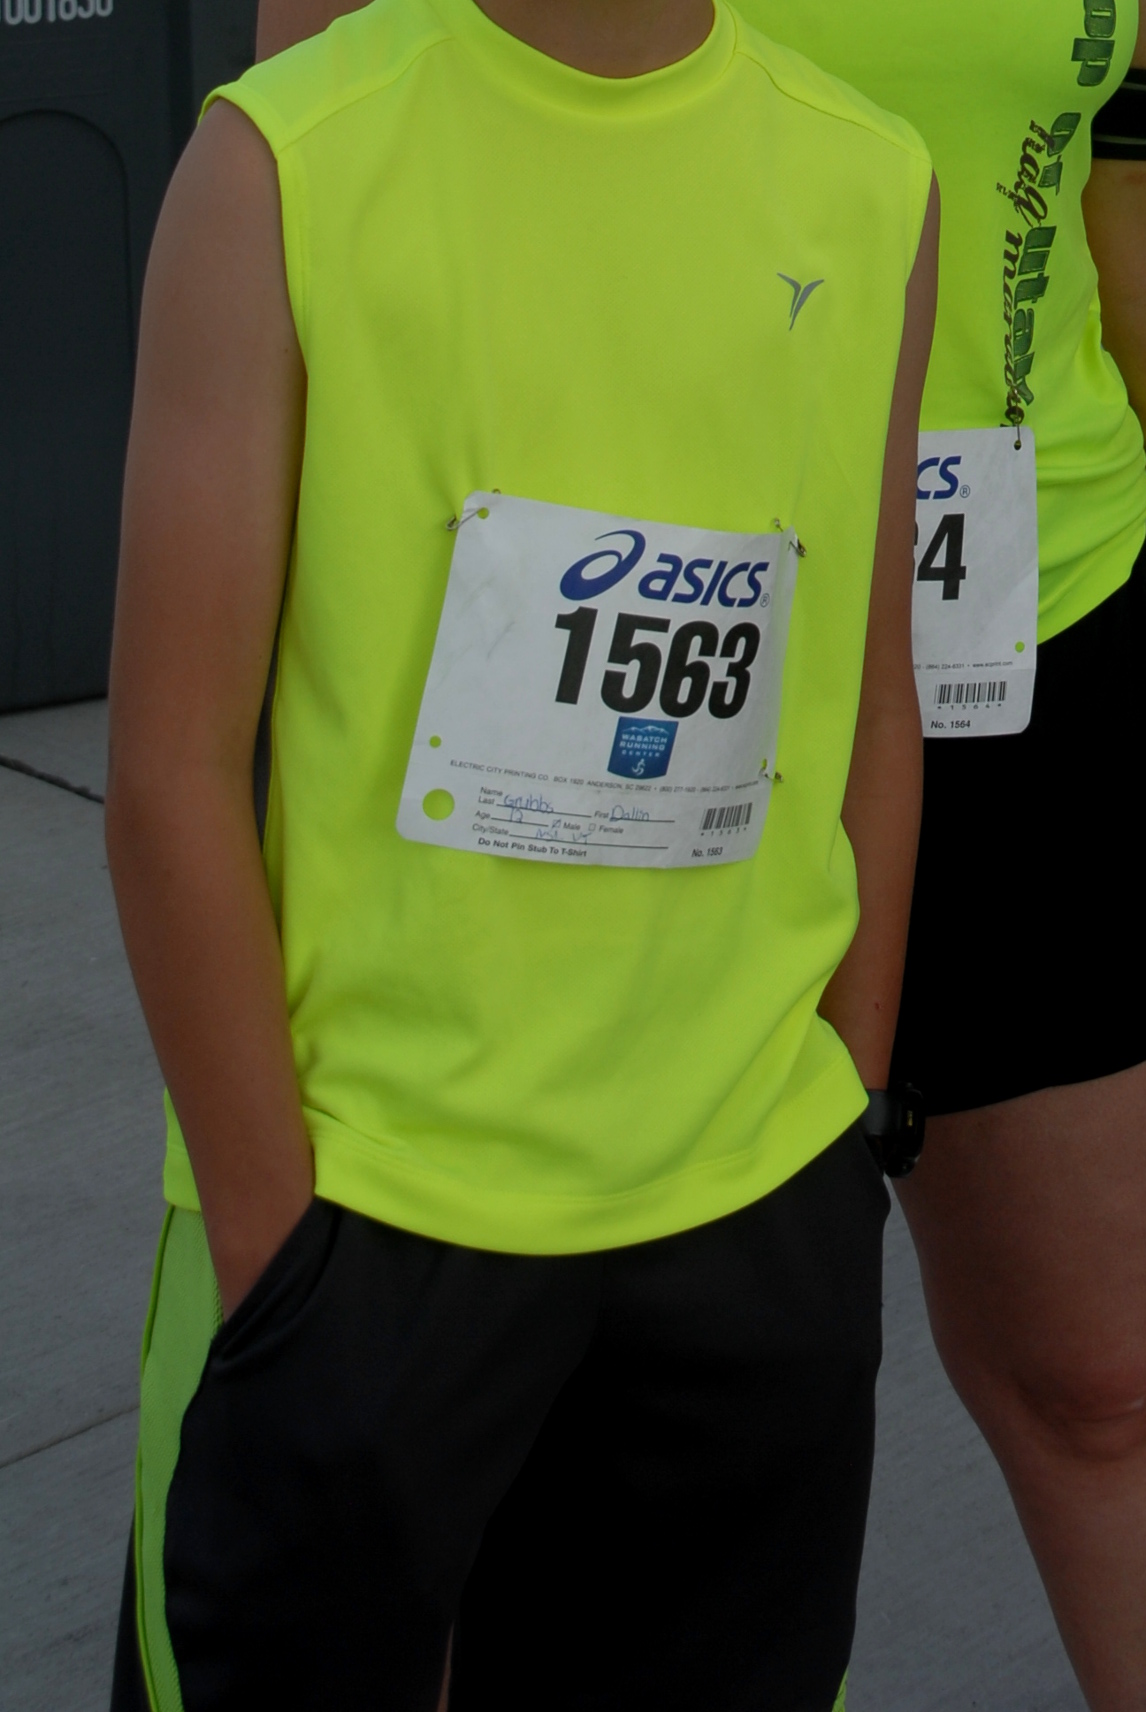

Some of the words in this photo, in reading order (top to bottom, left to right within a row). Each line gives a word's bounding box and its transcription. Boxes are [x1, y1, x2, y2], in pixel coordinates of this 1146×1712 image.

[999, 230, 1026, 427] maratho
[914, 513, 967, 601] 4
[637, 552, 770, 608] asics
[554, 606, 761, 719] 1563
[930, 720, 947, 729] No.
[950, 719, 971, 728] 1564
[619, 741, 666, 751] RUNNING
[450, 759, 485, 772] ELECTRIC
[486, 766, 502, 774] CITY
[504, 768, 537, 779] PRINTING
[480, 787, 504, 797] Name
[478, 796, 495, 805] Last
[594, 810, 609, 819] First
[472, 823, 509, 836] City/State
[475, 810, 491, 820] Age
[563, 822, 581, 831] Male
[599, 825, 624, 834] Female
[478, 837, 491, 846] Do
[493, 839, 509, 849] Not
[511, 842, 526, 851] Pin
[528, 844, 548, 853] Stub
[550, 846, 560, 855] To
[561, 848, 587, 857] T-Shirt
[691, 848, 705, 858] No.
[706, 846, 724, 857] 1563
